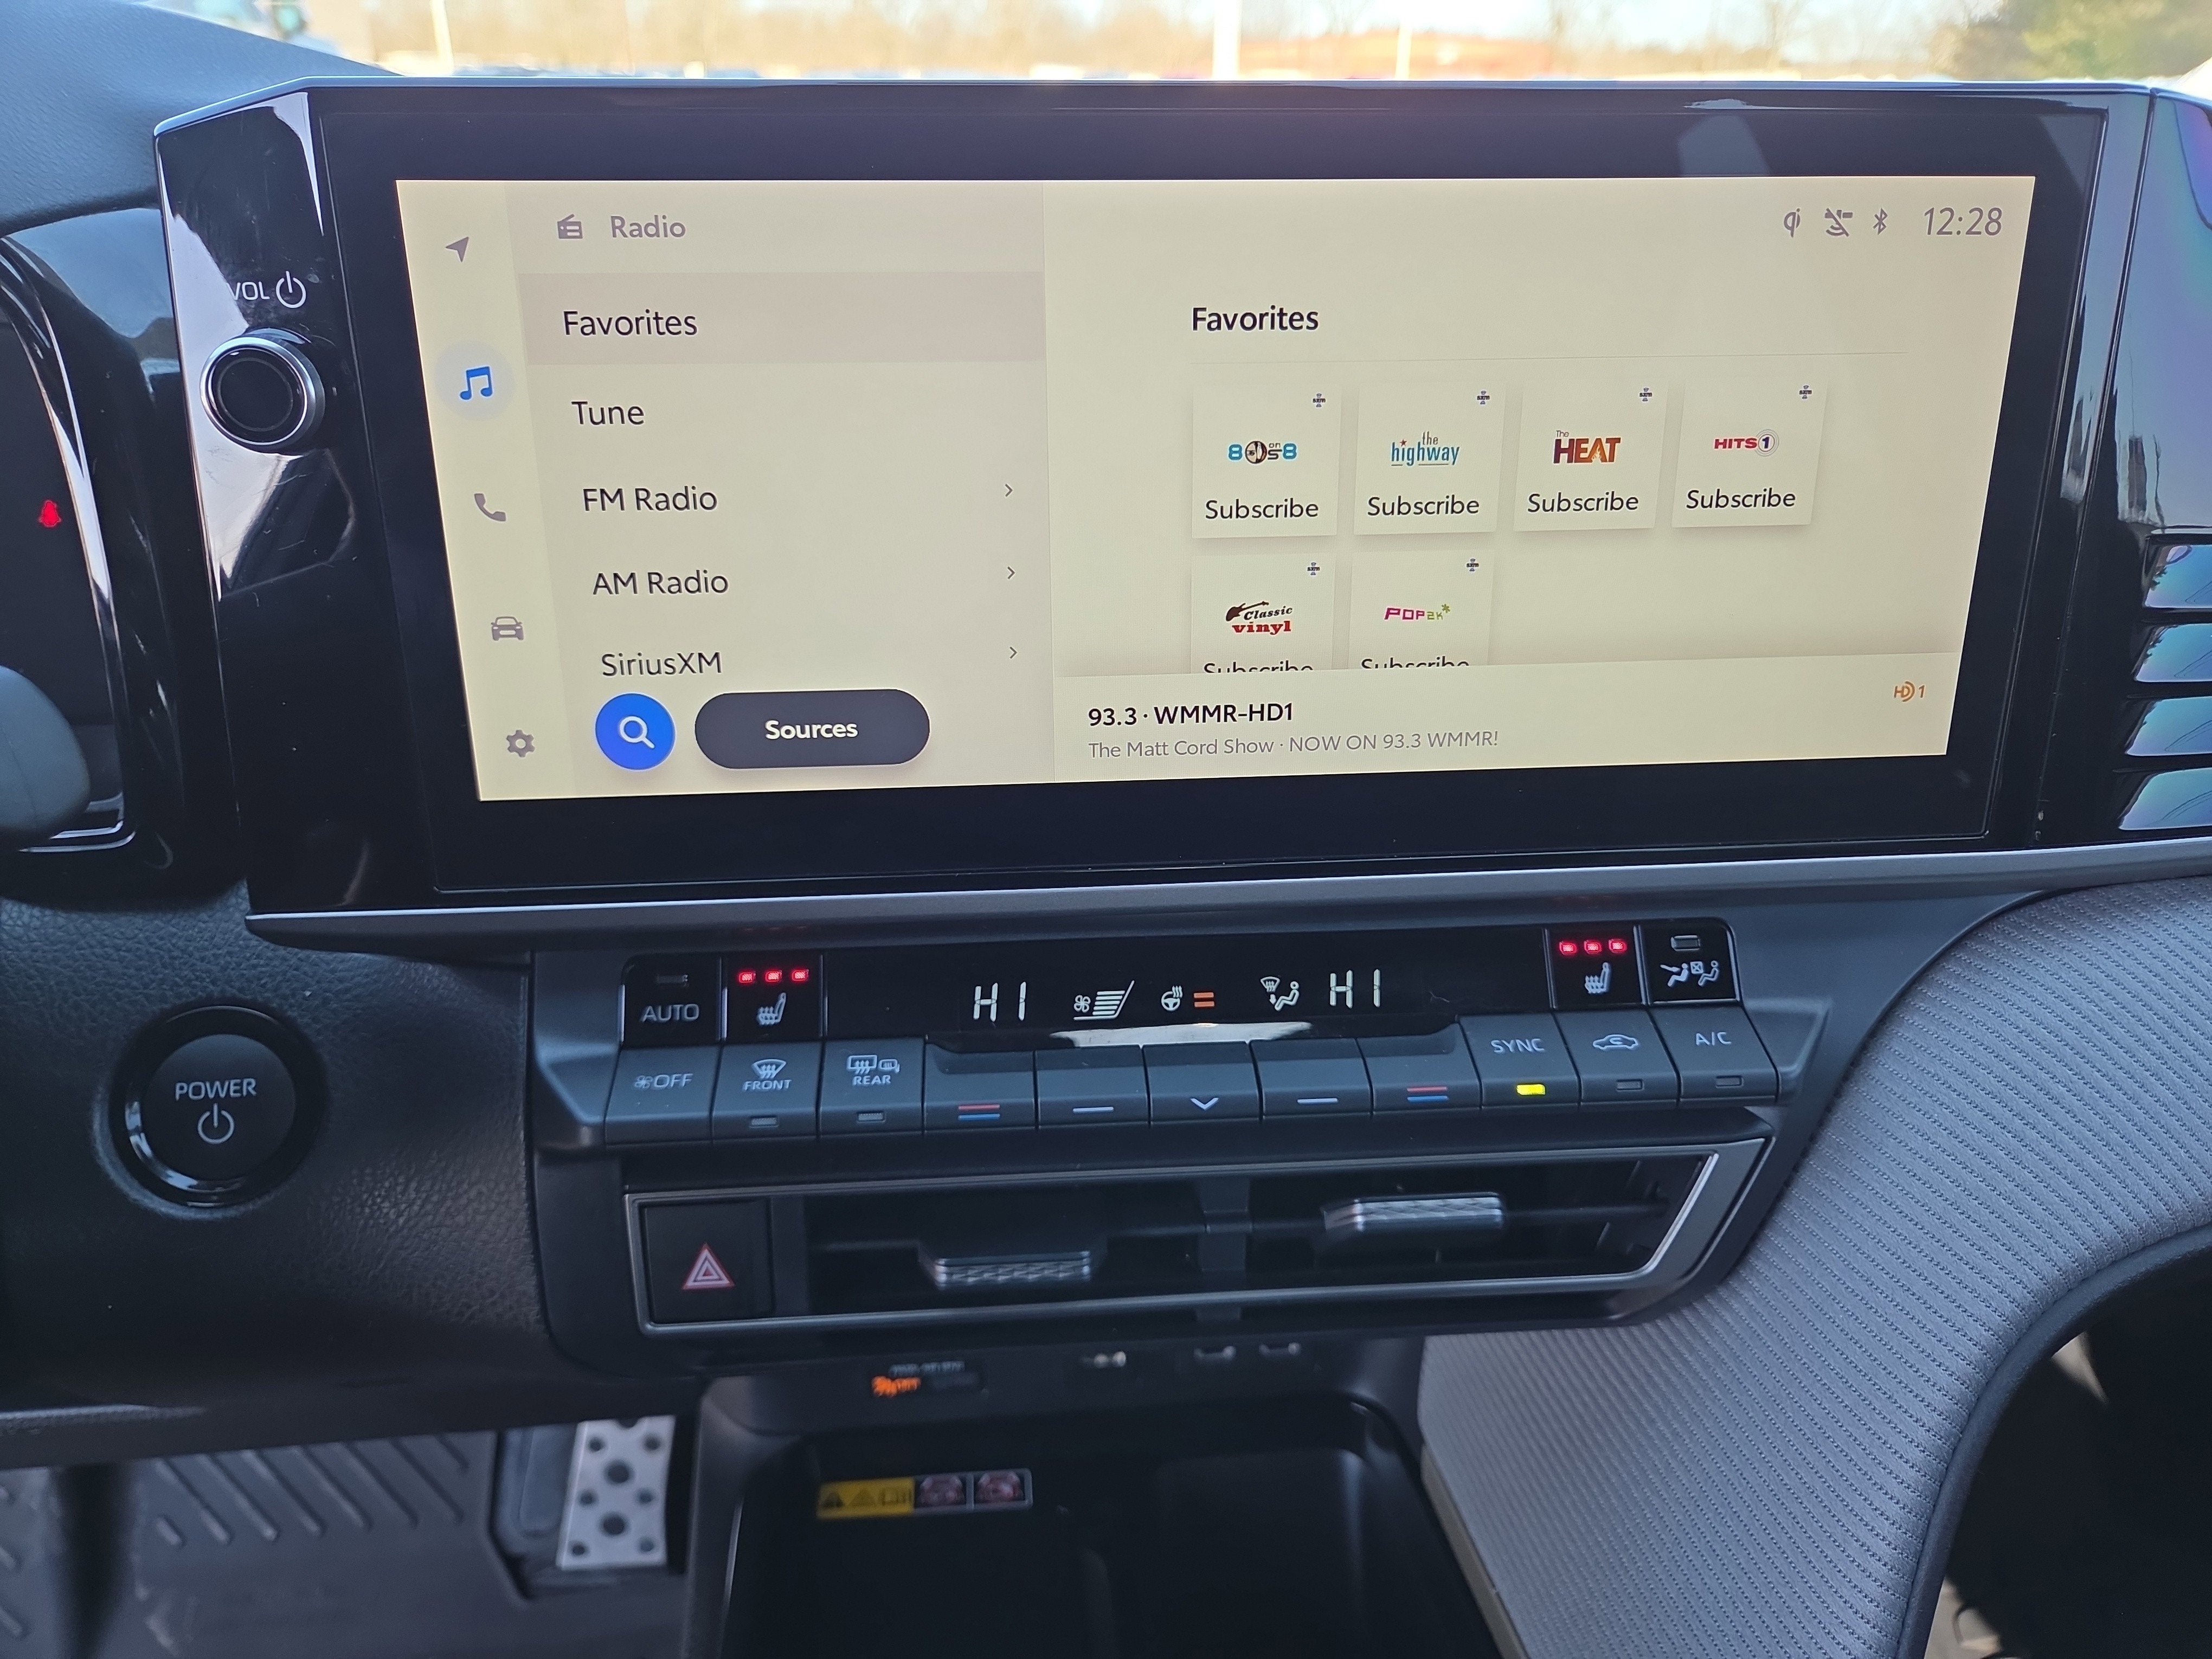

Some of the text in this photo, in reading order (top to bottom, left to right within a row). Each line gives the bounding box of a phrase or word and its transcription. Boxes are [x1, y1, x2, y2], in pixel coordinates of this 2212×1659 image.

[611, 215, 686, 239] Radio
[1925, 207, 2003, 236] 12:28
[228, 281, 271, 300] VOL
[564, 309, 698, 337] Favorites
[1193, 305, 1319, 332] Favorites
[571, 401, 645, 426] Tune
[1423, 432, 1439, 446] the
[1553, 437, 1622, 464] HEAT
[1391, 441, 1461, 466] highway
[583, 486, 718, 512] FM Radio
[1206, 498, 1319, 520] Subscribe
[1368, 494, 1480, 517] Subscribe
[1528, 491, 1639, 513] Subscribe
[1687, 487, 1796, 510] Subscribe
[593, 570, 729, 596] AM Radio
[1243, 606, 1294, 621] Classic
[1231, 621, 1292, 636] vinyl
[602, 652, 722, 677] SiriusXM
[1089, 708, 1137, 727] 93.3
[1154, 703, 1293, 725] WMMR-HD1
[766, 721, 859, 740] Sources
[1089, 742, 1122, 759] The
[1128, 742, 1170, 757] Matt
[1175, 739, 1218, 756] Cord
[1224, 738, 1275, 755] Show
[1290, 736, 1342, 753] NOW
[1347, 735, 1377, 750] ON
[1384, 734, 1422, 750] 93.3
[1428, 731, 1499, 748] WMMR!
[640, 1003, 700, 1023] AUTO
[1490, 1038, 1545, 1053] SYNC
[1696, 1032, 1732, 1046] A/C
[175, 1078, 258, 1101] POWER
[653, 1073, 694, 1089] OFF
[743, 1077, 792, 1091] FRONT
[853, 1075, 891, 1086] REAR
